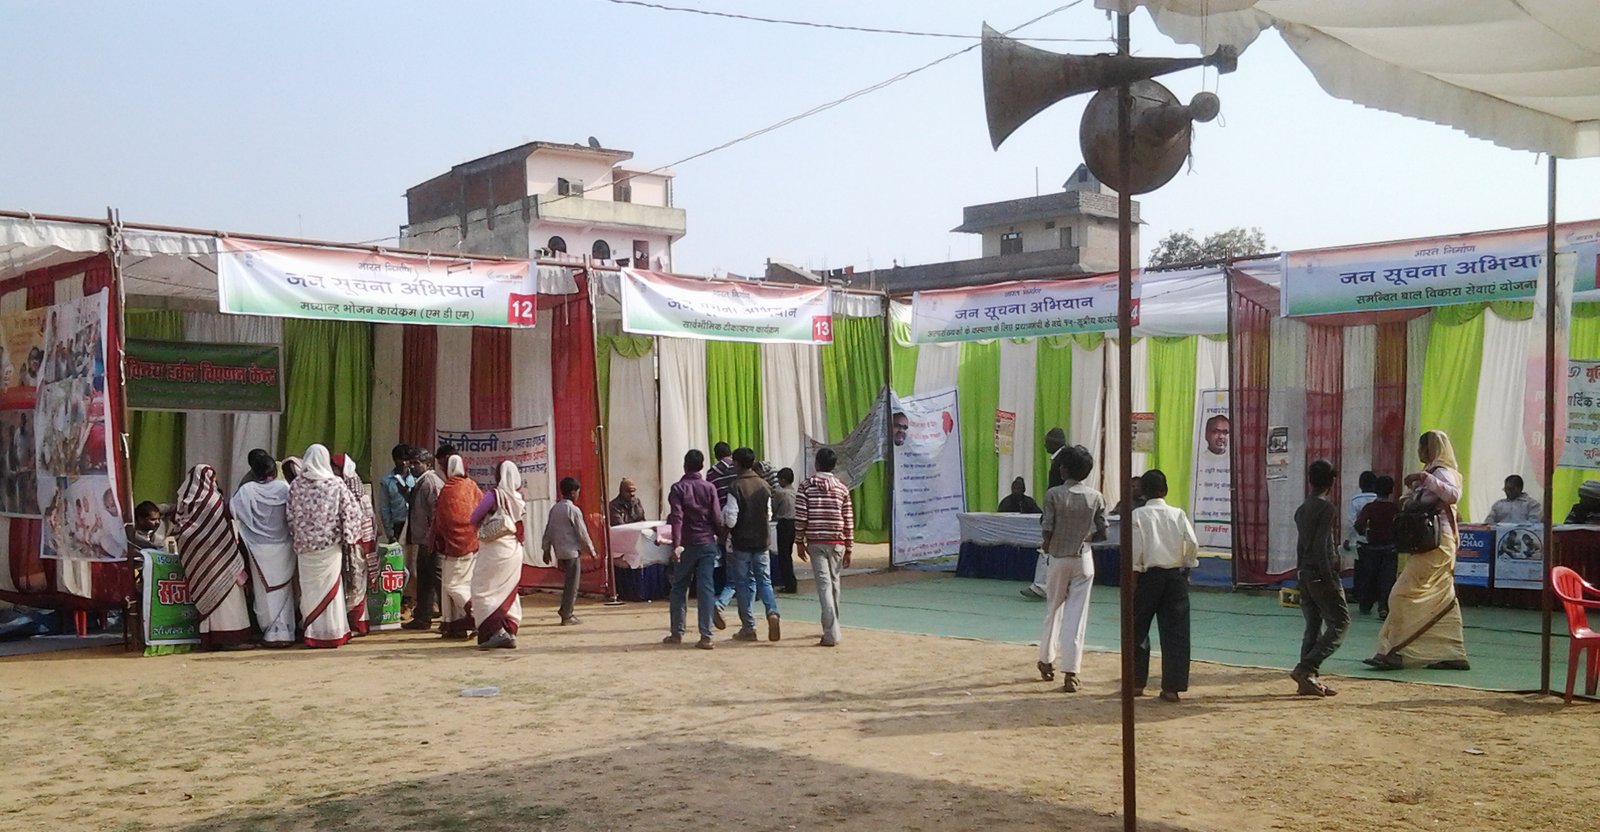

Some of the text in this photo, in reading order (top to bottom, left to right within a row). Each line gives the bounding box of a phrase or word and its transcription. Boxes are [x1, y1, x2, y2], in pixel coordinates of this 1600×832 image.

[1414, 243, 1476, 257] भारत निर्माण
[358, 262, 381, 273] भारत
[1339, 254, 1542, 285] जन सूचना अभिया
[286, 272, 325, 289] जन
[331, 277, 392, 296] सूचना
[401, 279, 485, 299] अभियान
[1356, 279, 1538, 304] समन्वित बाल विकास सेवाएं योजना
[343, 300, 374, 315] भोजन
[377, 303, 417, 318] कार्यक्रम
[443, 307, 452, 319] डी
[511, 300, 533, 319] 12
[955, 296, 1094, 321] जन सूचना अभियान
[1131, 304, 1139, 320] 4
[815, 321, 830, 336] 13
[1459, 540, 1484, 548] CHAO
[1460, 532, 1474, 540] TAX
